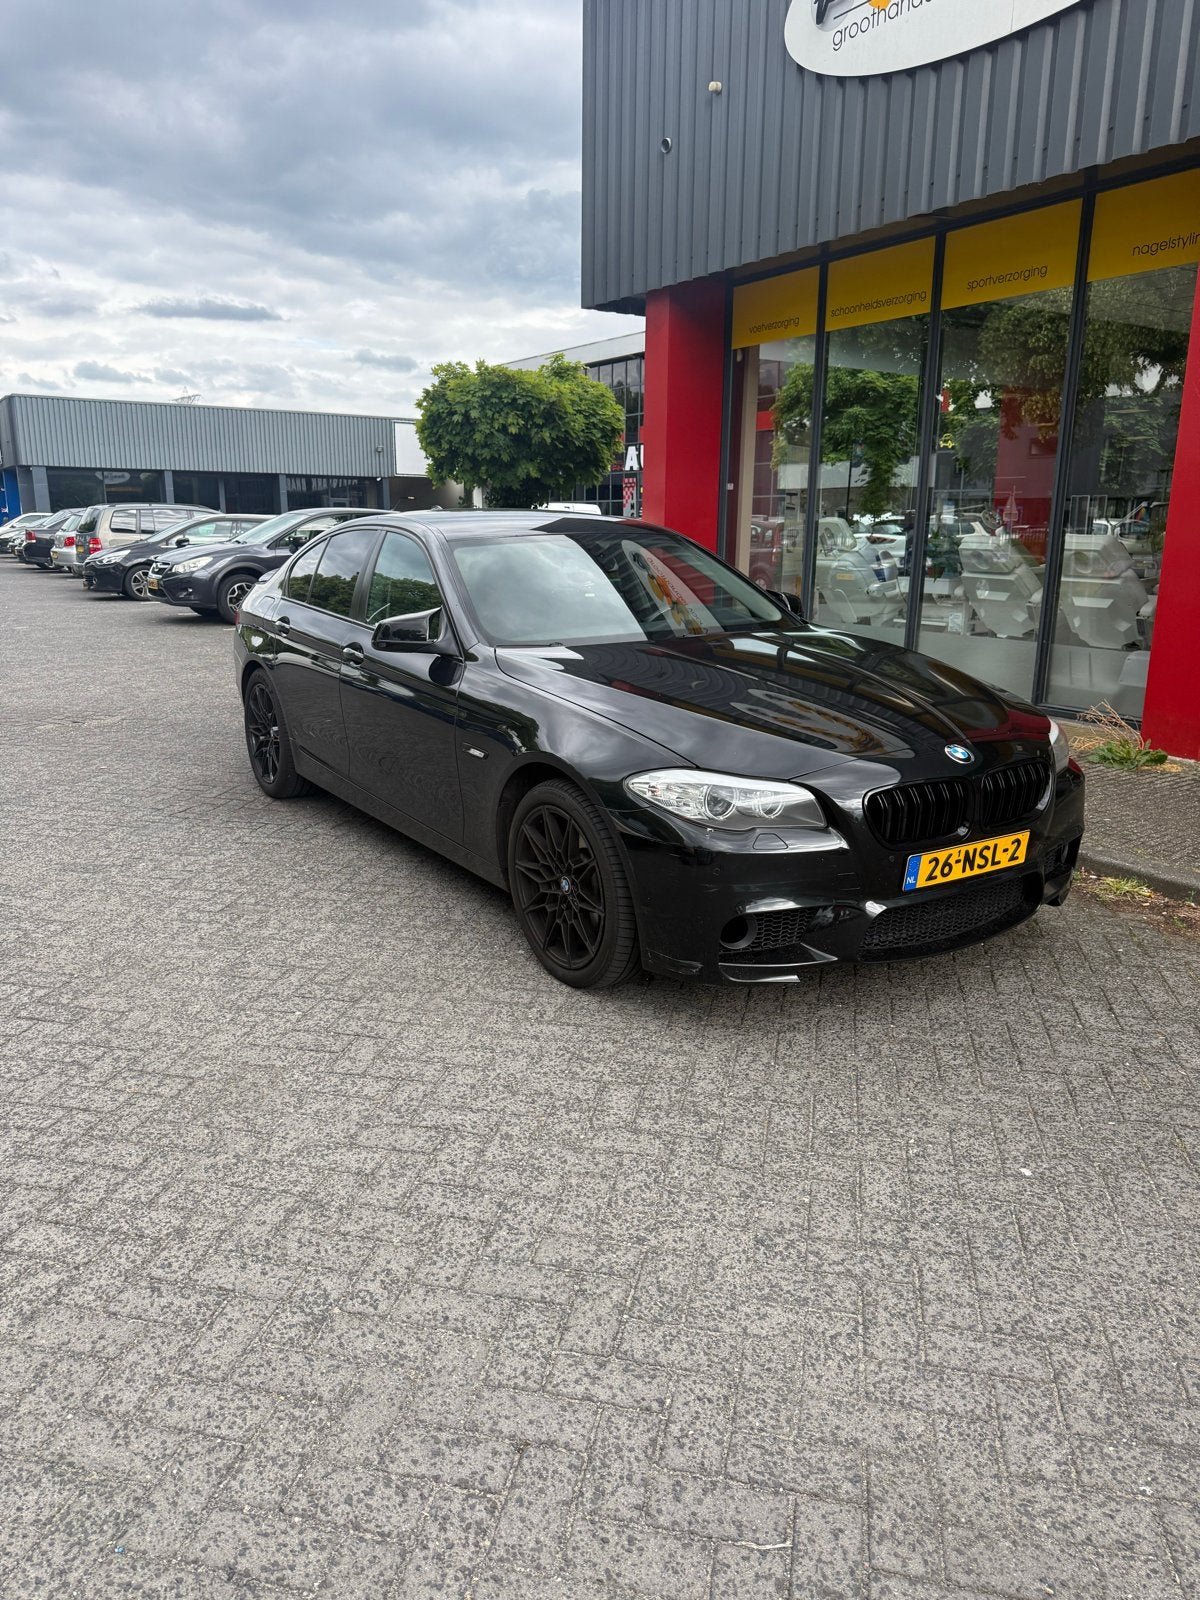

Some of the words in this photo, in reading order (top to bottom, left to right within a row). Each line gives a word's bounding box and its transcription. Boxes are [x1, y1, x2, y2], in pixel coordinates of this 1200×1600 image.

[833, 0, 932, 51] groothan
[967, 264, 1048, 292] sportverzorging
[830, 290, 927, 318] schoonheidsverzorging
[749, 316, 800, 334] voetverzorging
[924, 838, 1022, 882] 26-NSL-2
